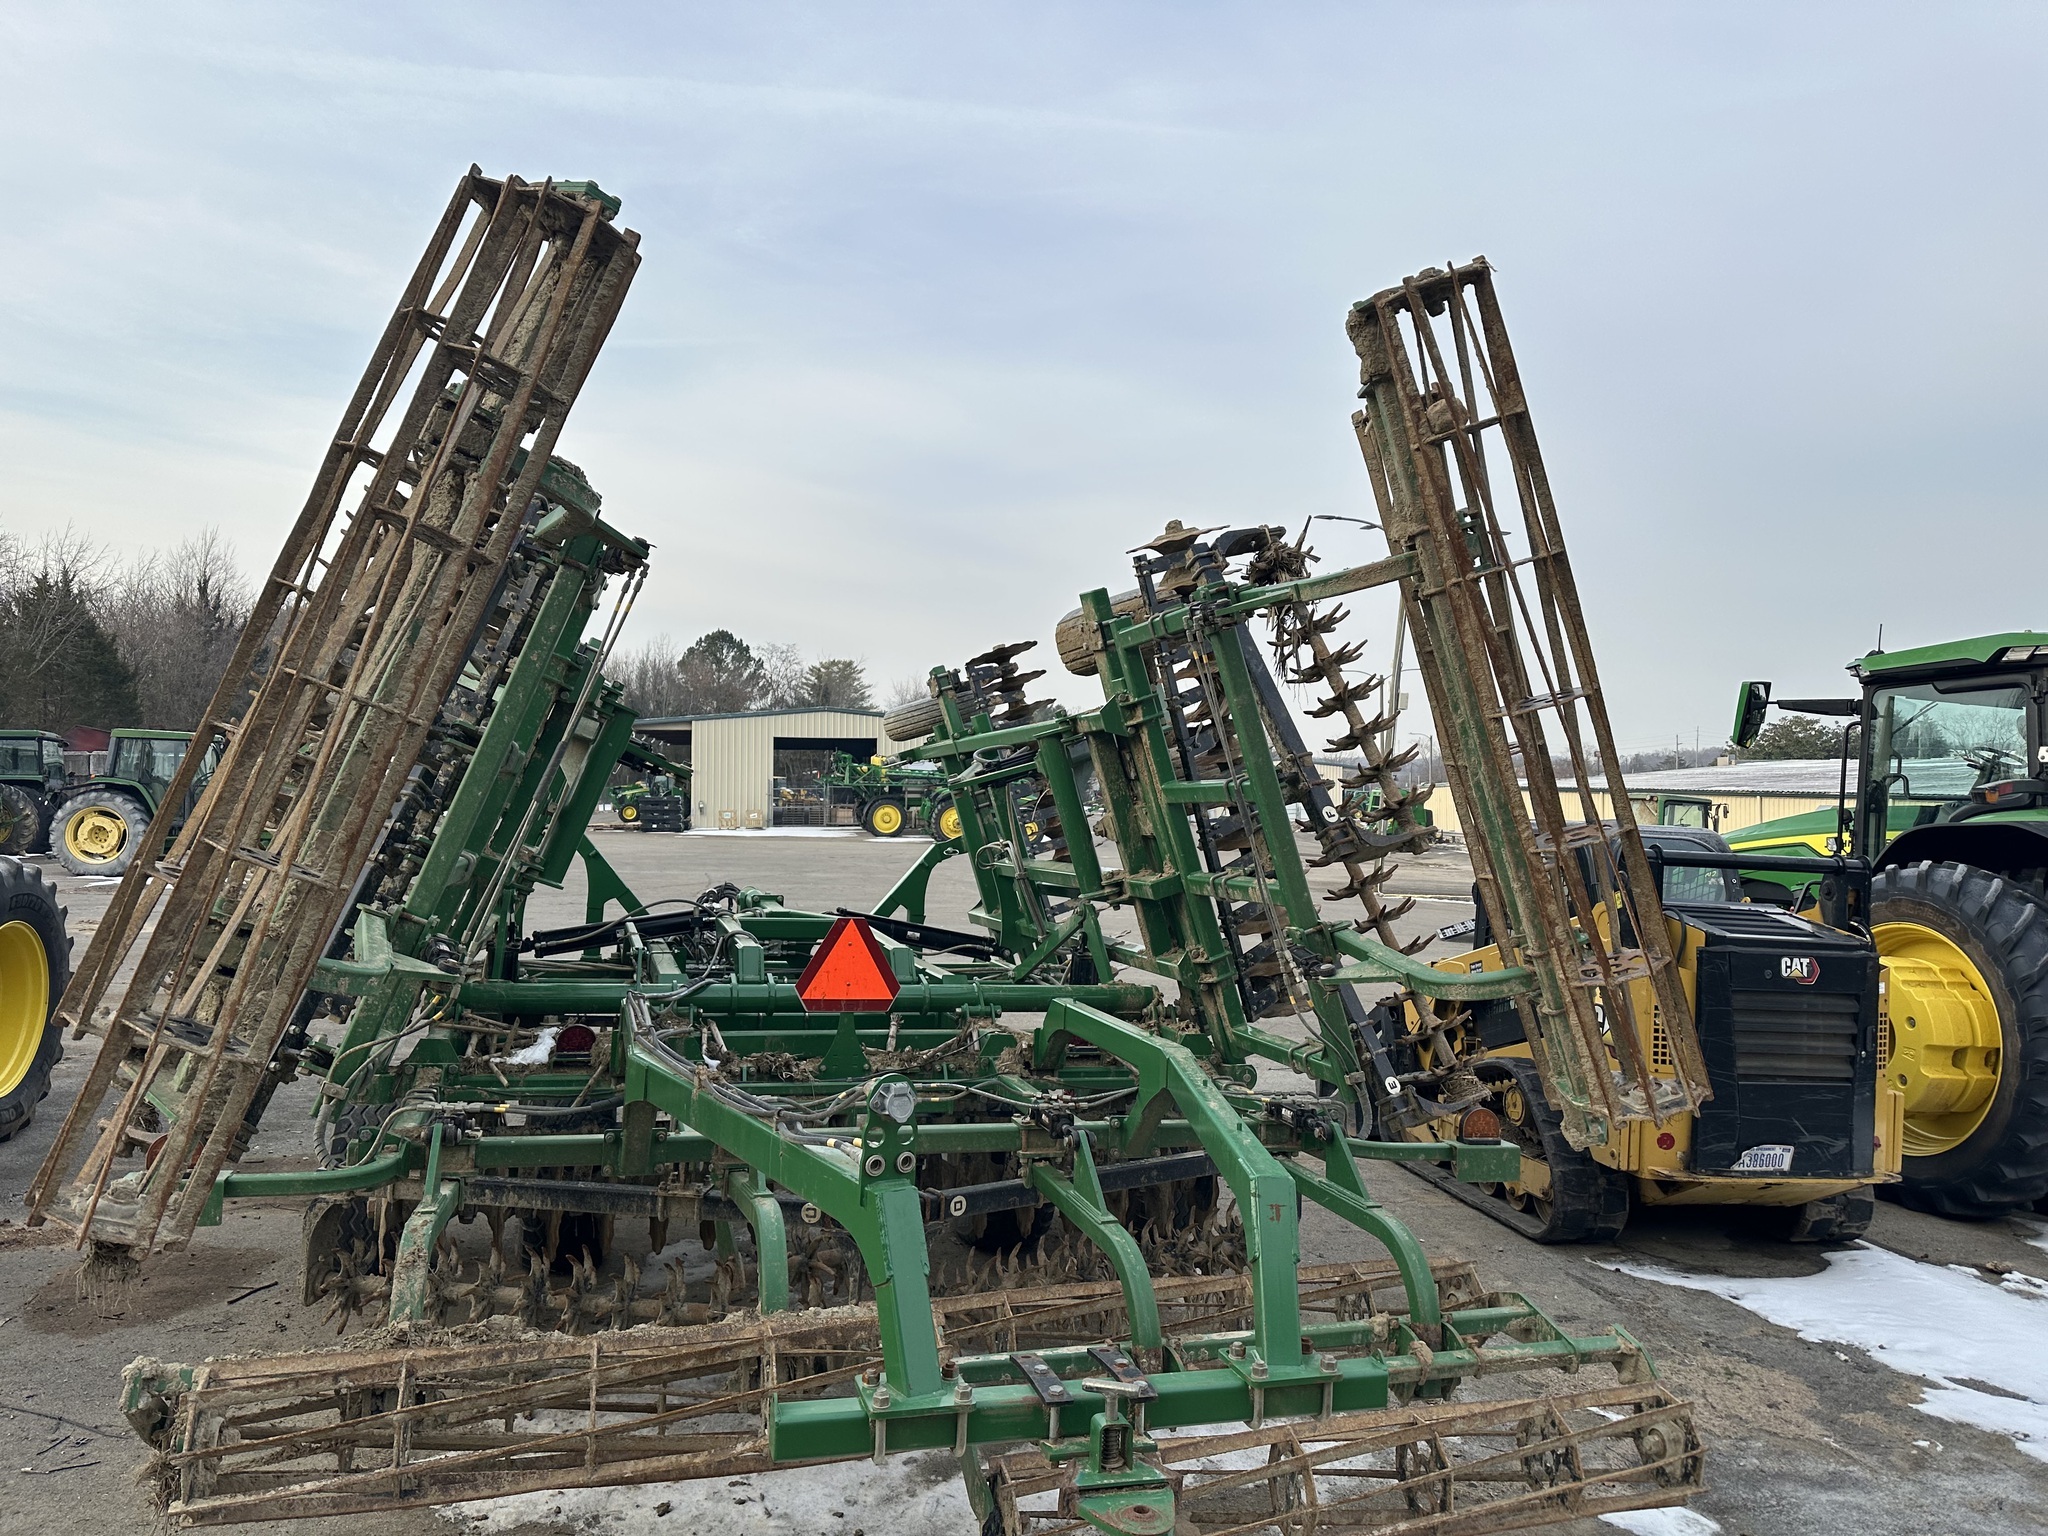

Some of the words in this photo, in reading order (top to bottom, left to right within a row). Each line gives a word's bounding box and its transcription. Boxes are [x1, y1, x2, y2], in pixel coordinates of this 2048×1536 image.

[1325, 811, 1336, 819] F
[1781, 957, 1810, 977] CAT
[1388, 1081, 1398, 1090] E
